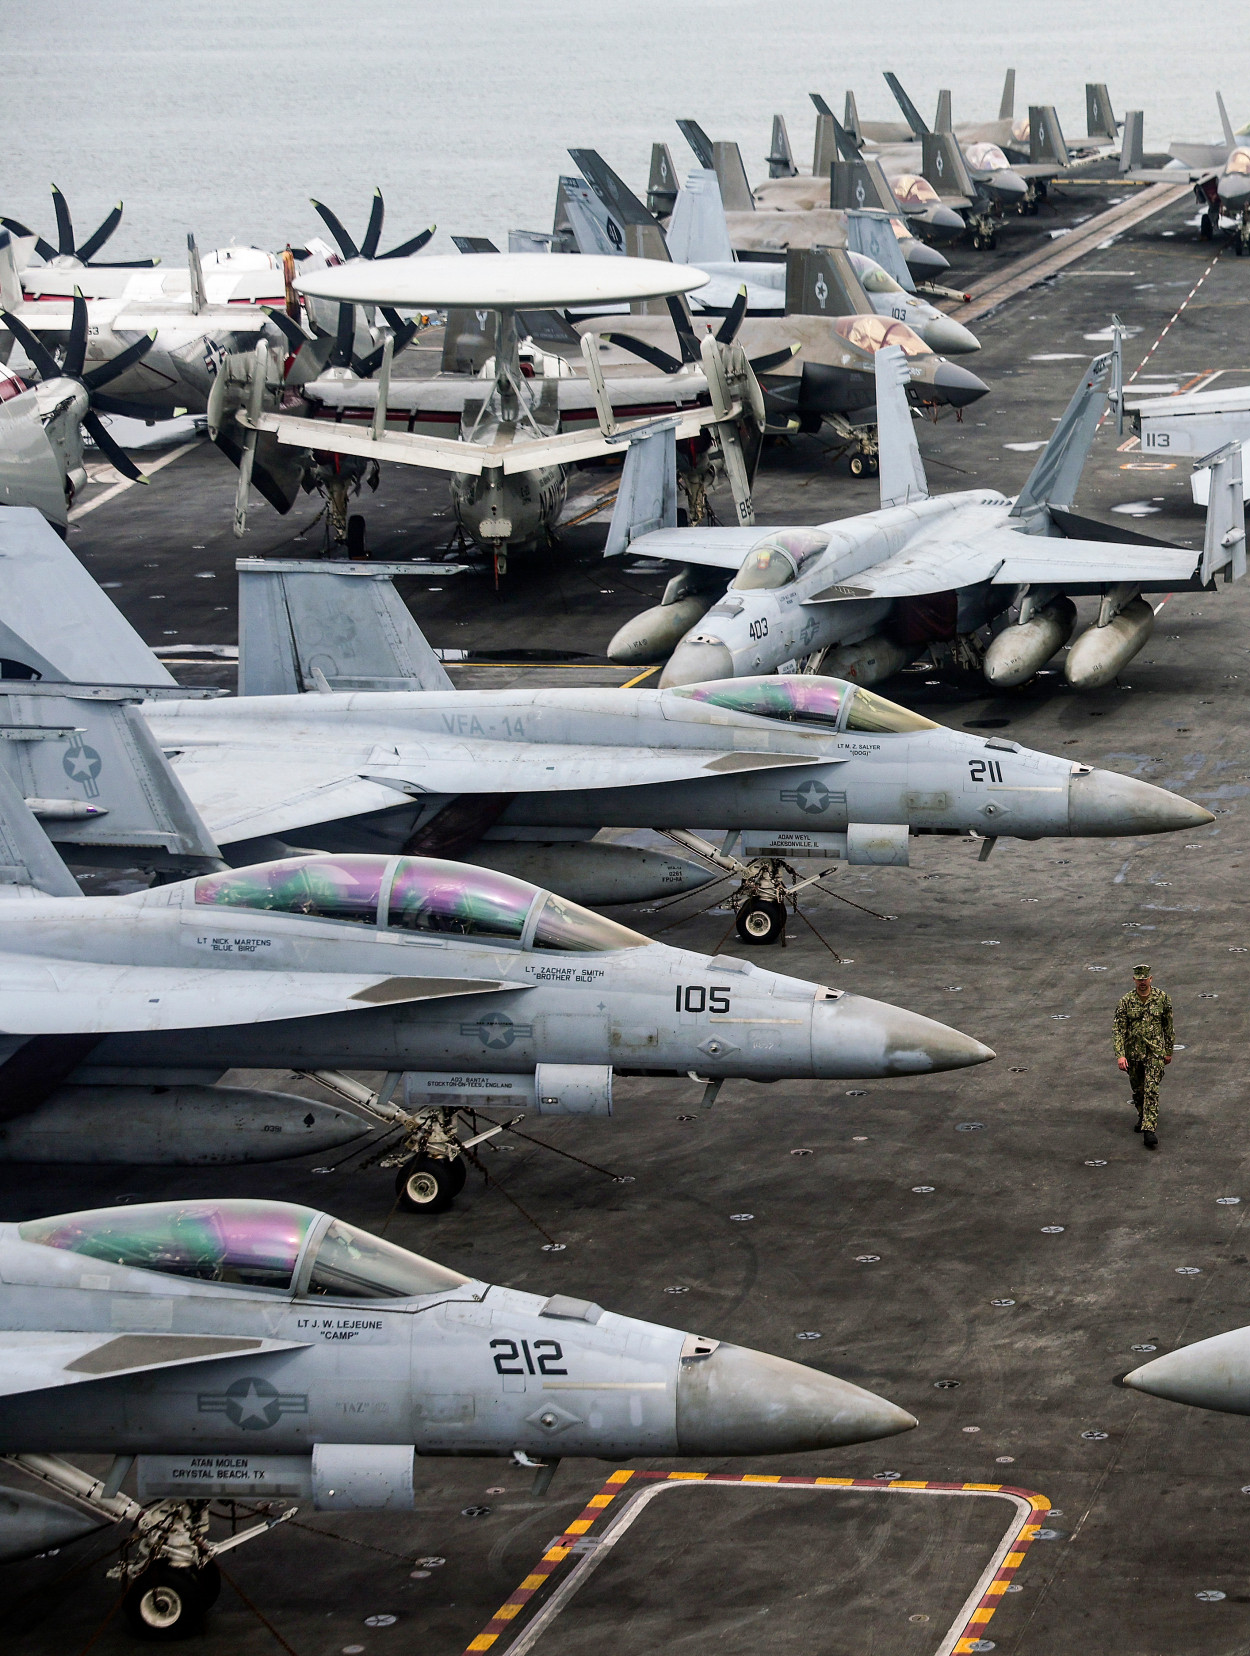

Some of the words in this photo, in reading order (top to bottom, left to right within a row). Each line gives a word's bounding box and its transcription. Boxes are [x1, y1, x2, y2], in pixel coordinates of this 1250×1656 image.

[891, 307, 906, 320] 103
[1146, 432, 1171, 447] 113
[749, 617, 769, 642] 403
[968, 760, 1003, 783] 211
[541, 967, 576, 975] ZACHARY
[675, 985, 731, 1013] 105
[297, 1320, 309, 1328] LT
[312, 1320, 320, 1328] J.
[322, 1320, 335, 1328] W.
[337, 1320, 383, 1329] LEJEUNE
[320, 1331, 359, 1340] "CAMP"
[489, 1338, 568, 1375] 212
[191, 1458, 213, 1467] ATAN
[216, 1458, 248, 1468] MOLEN
[172, 1469, 214, 1478] CRYSTAL
[217, 1470, 250, 1479] BEACH,
[253, 1470, 265, 1479] TX
